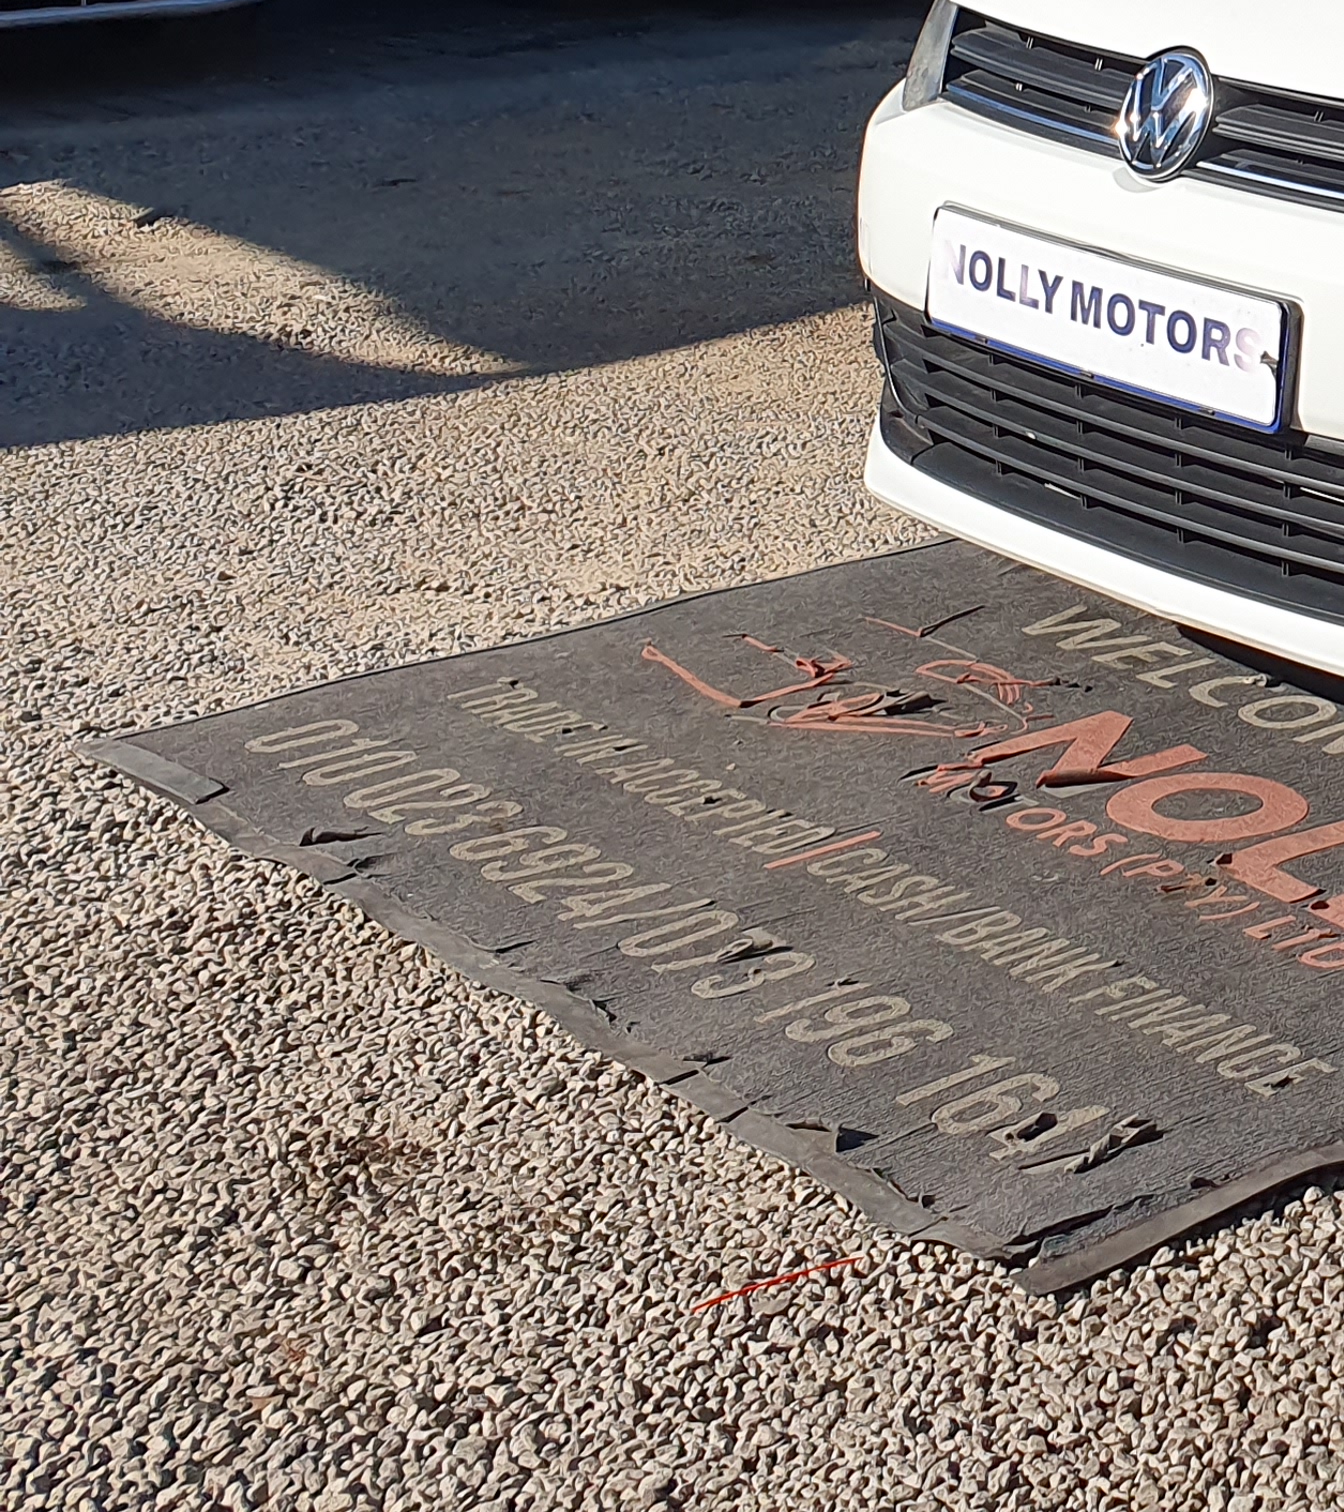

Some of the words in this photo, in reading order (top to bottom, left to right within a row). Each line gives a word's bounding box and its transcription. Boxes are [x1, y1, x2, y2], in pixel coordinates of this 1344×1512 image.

[946, 240, 1063, 315] NOLLY
[1070, 280, 1262, 374] MOTORS
[243, 718, 420, 788] 010
[344, 766, 520, 838] 023
[752, 978, 955, 1070] 196
[448, 676, 604, 742] TRADE
[553, 724, 638, 769] IN
[597, 756, 836, 852] ACCEPTED
[1064, 975, 1337, 1098] FINANCE
